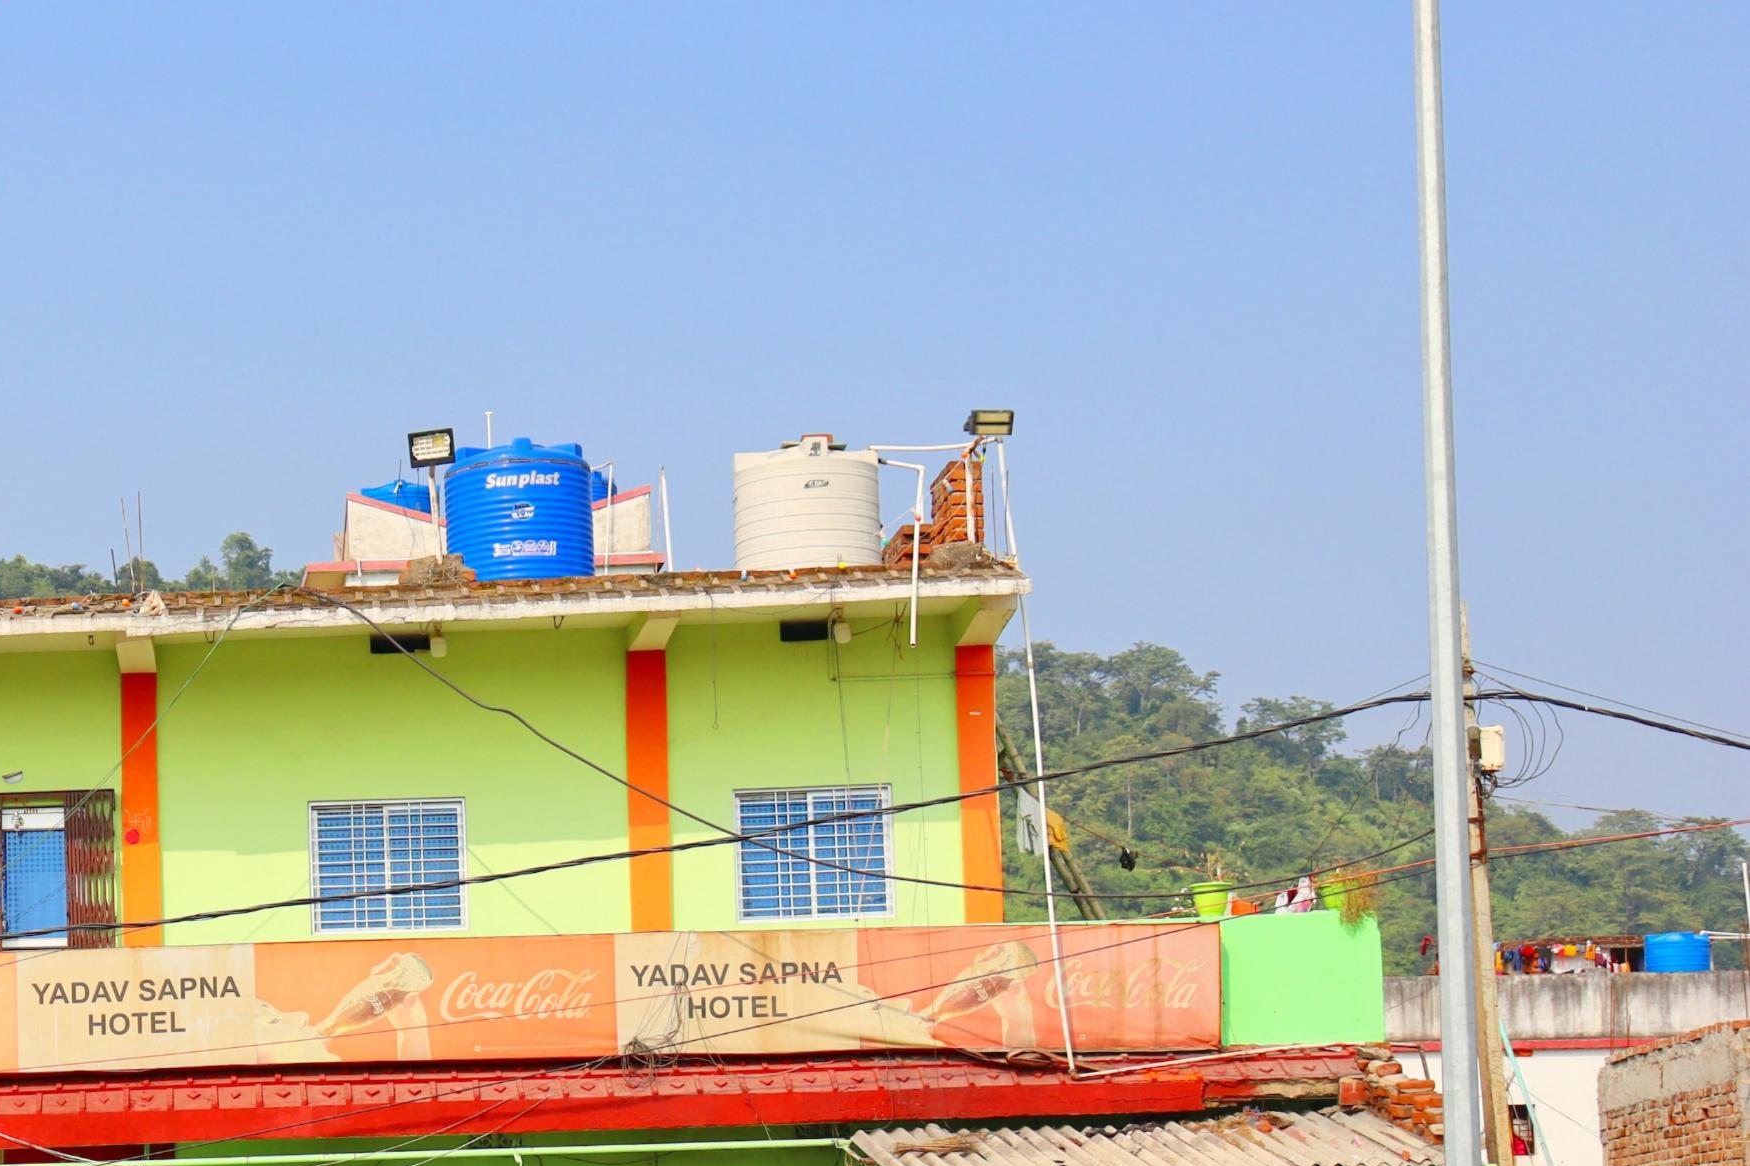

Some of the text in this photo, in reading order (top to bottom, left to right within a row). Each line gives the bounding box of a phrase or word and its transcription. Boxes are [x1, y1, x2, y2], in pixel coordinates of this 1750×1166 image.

[630, 961, 843, 988] YADAV SAPNA
[32, 976, 241, 1006] YADAV SAPNA
[440, 969, 600, 1024] Coca-Cola
[688, 996, 788, 1020] HOTEL
[88, 1011, 186, 1036] HOTEL
